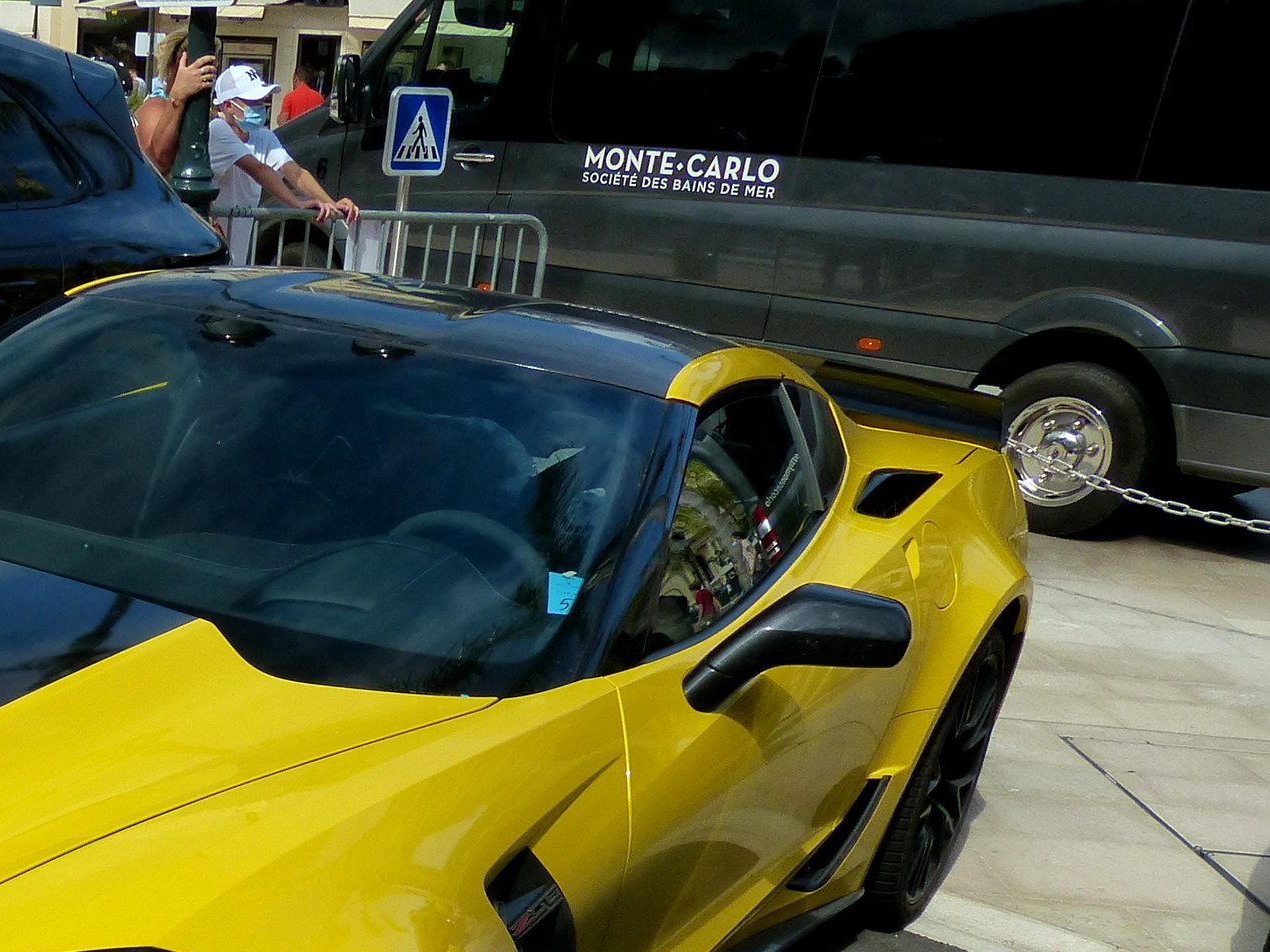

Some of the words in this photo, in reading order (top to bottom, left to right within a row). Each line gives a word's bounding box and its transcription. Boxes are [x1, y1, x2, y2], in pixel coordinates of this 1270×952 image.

[581, 170, 638, 187] SOCIÉTÉ
[641, 175, 668, 190] DES
[672, 178, 716, 194] BAINS
[719, 183, 740, 196] DE
[744, 184, 776, 199] MER
